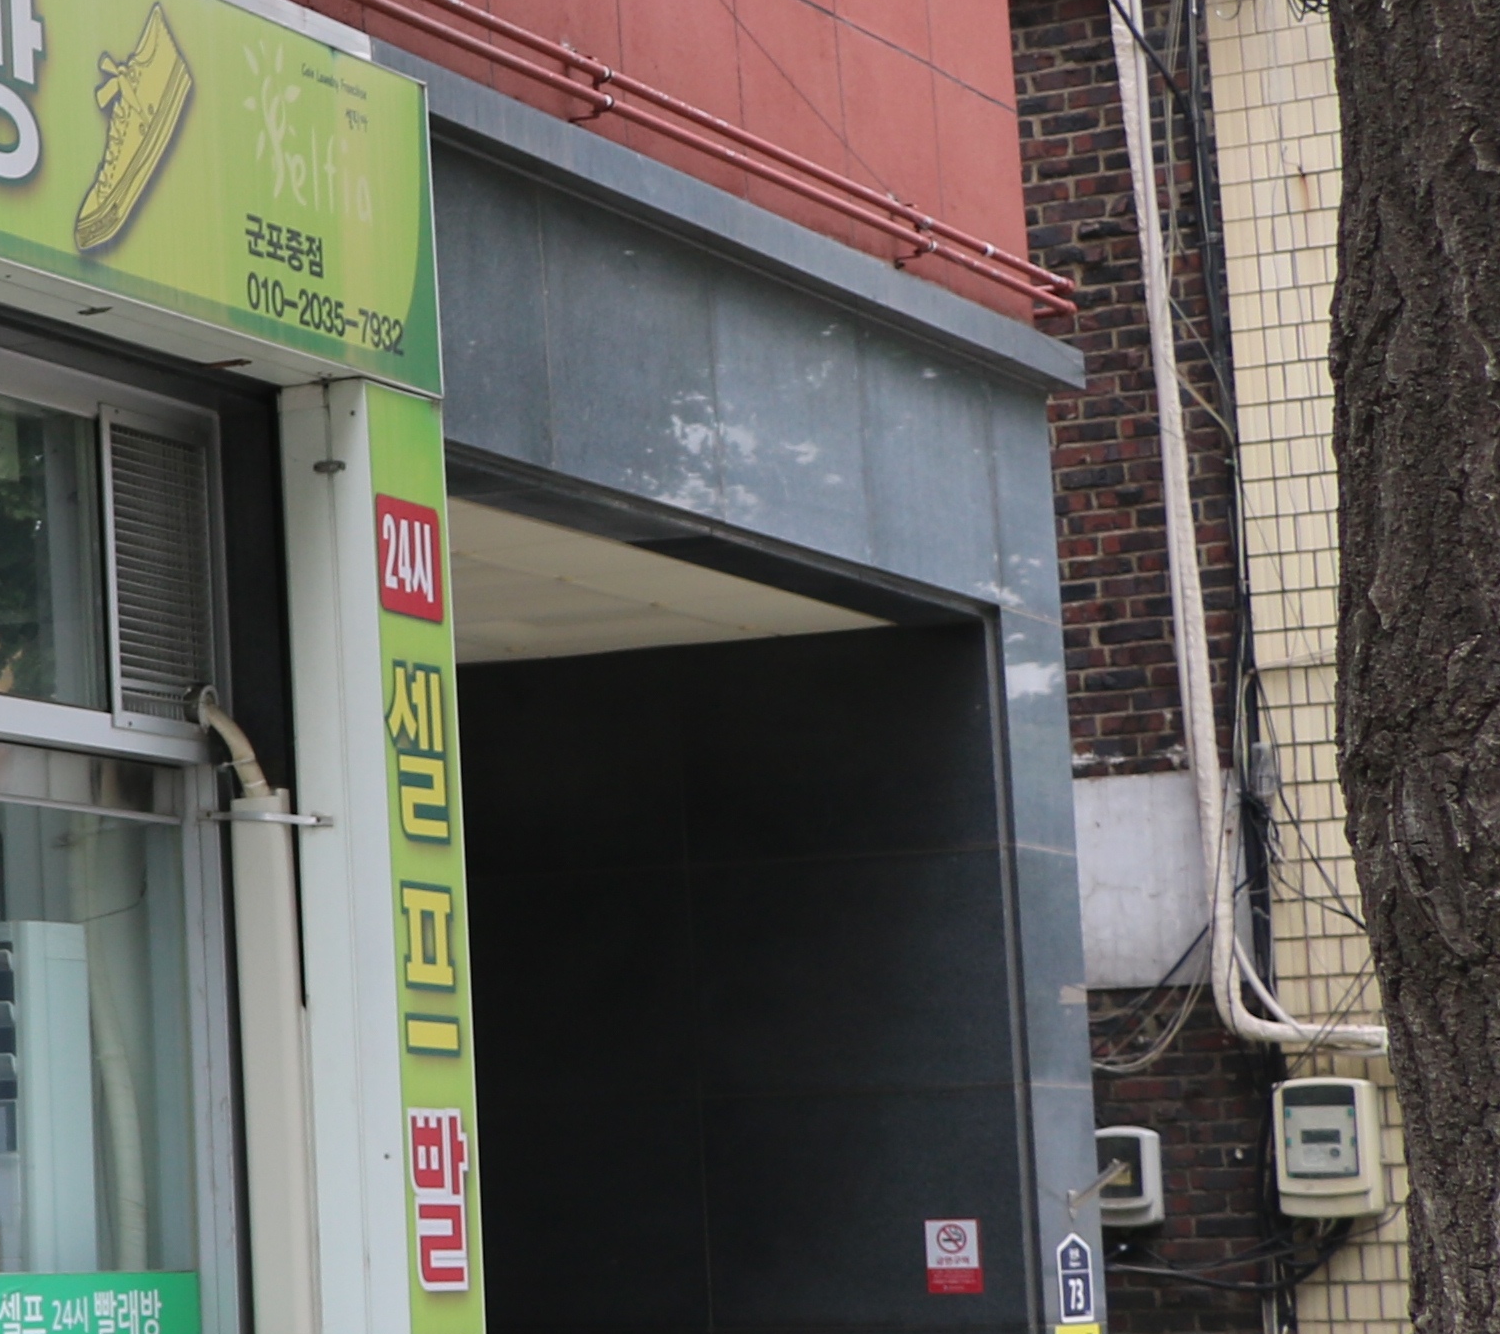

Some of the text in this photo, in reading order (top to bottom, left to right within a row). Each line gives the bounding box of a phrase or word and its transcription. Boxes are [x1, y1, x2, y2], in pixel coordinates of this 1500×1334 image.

[247, 271, 405, 356] 010-2035-7932
[382, 513, 435, 604] 24시
[51, 1296, 90, 1334] 24시
[1068, 1277, 1085, 1311] 73
